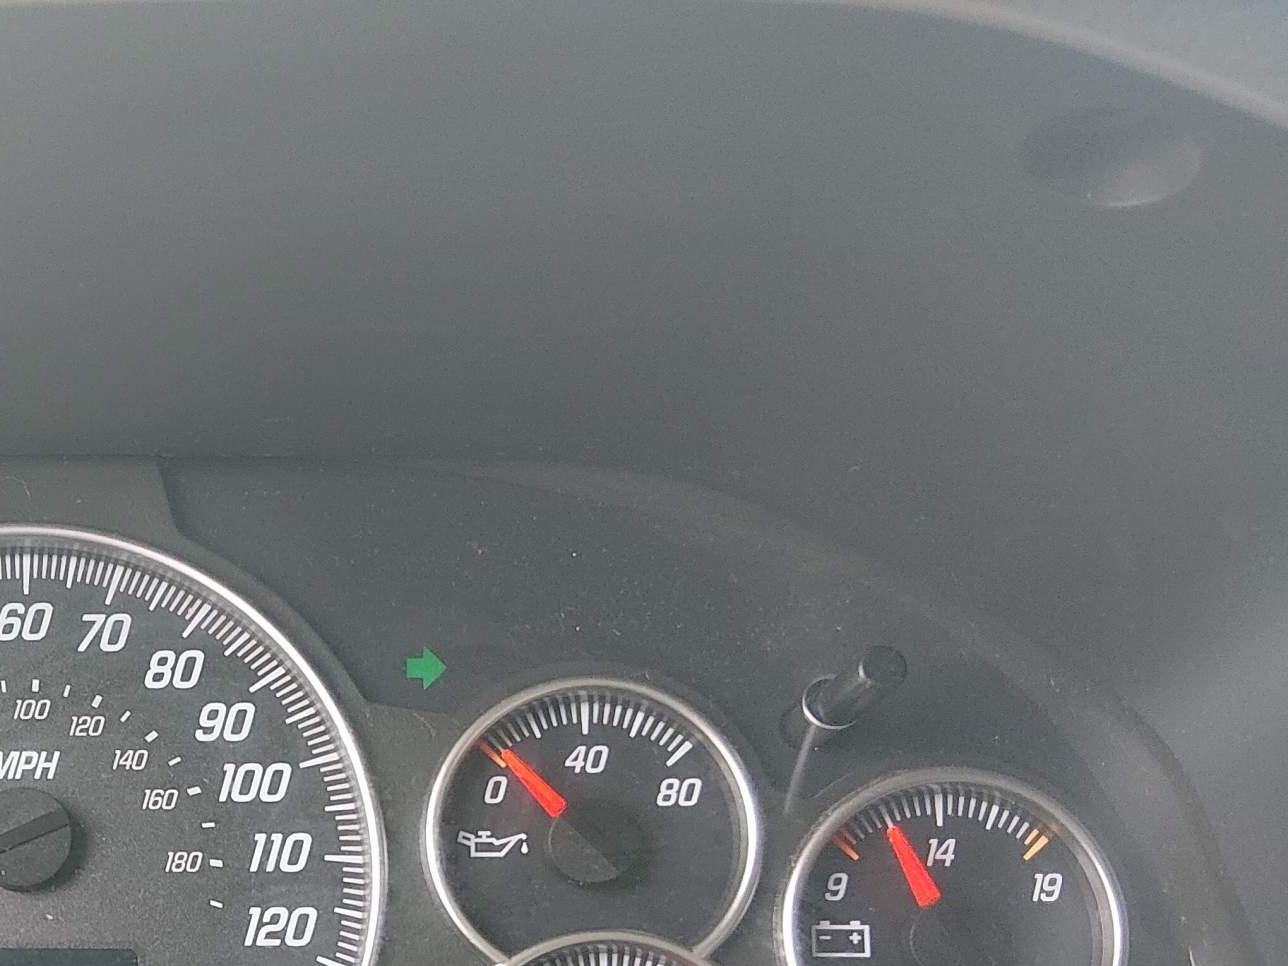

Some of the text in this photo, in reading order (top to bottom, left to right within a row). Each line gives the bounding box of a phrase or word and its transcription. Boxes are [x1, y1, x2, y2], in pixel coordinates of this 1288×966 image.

[78, 614, 131, 651] 70
[145, 650, 204, 688] 80
[14, 700, 50, 719] 100
[195, 703, 255, 741] 90
[70, 716, 104, 736] 120
[113, 750, 148, 769] 140
[565, 746, 608, 773] 40
[219, 763, 291, 802] 100
[485, 776, 507, 803] 0
[657, 779, 701, 806] 80
[143, 790, 178, 809] 160
[166, 852, 202, 872] 180
[249, 833, 313, 873] 110
[927, 839, 955, 866] 14
[825, 873, 848, 900] 9
[1033, 873, 1062, 901] 19
[245, 907, 317, 946] 120
